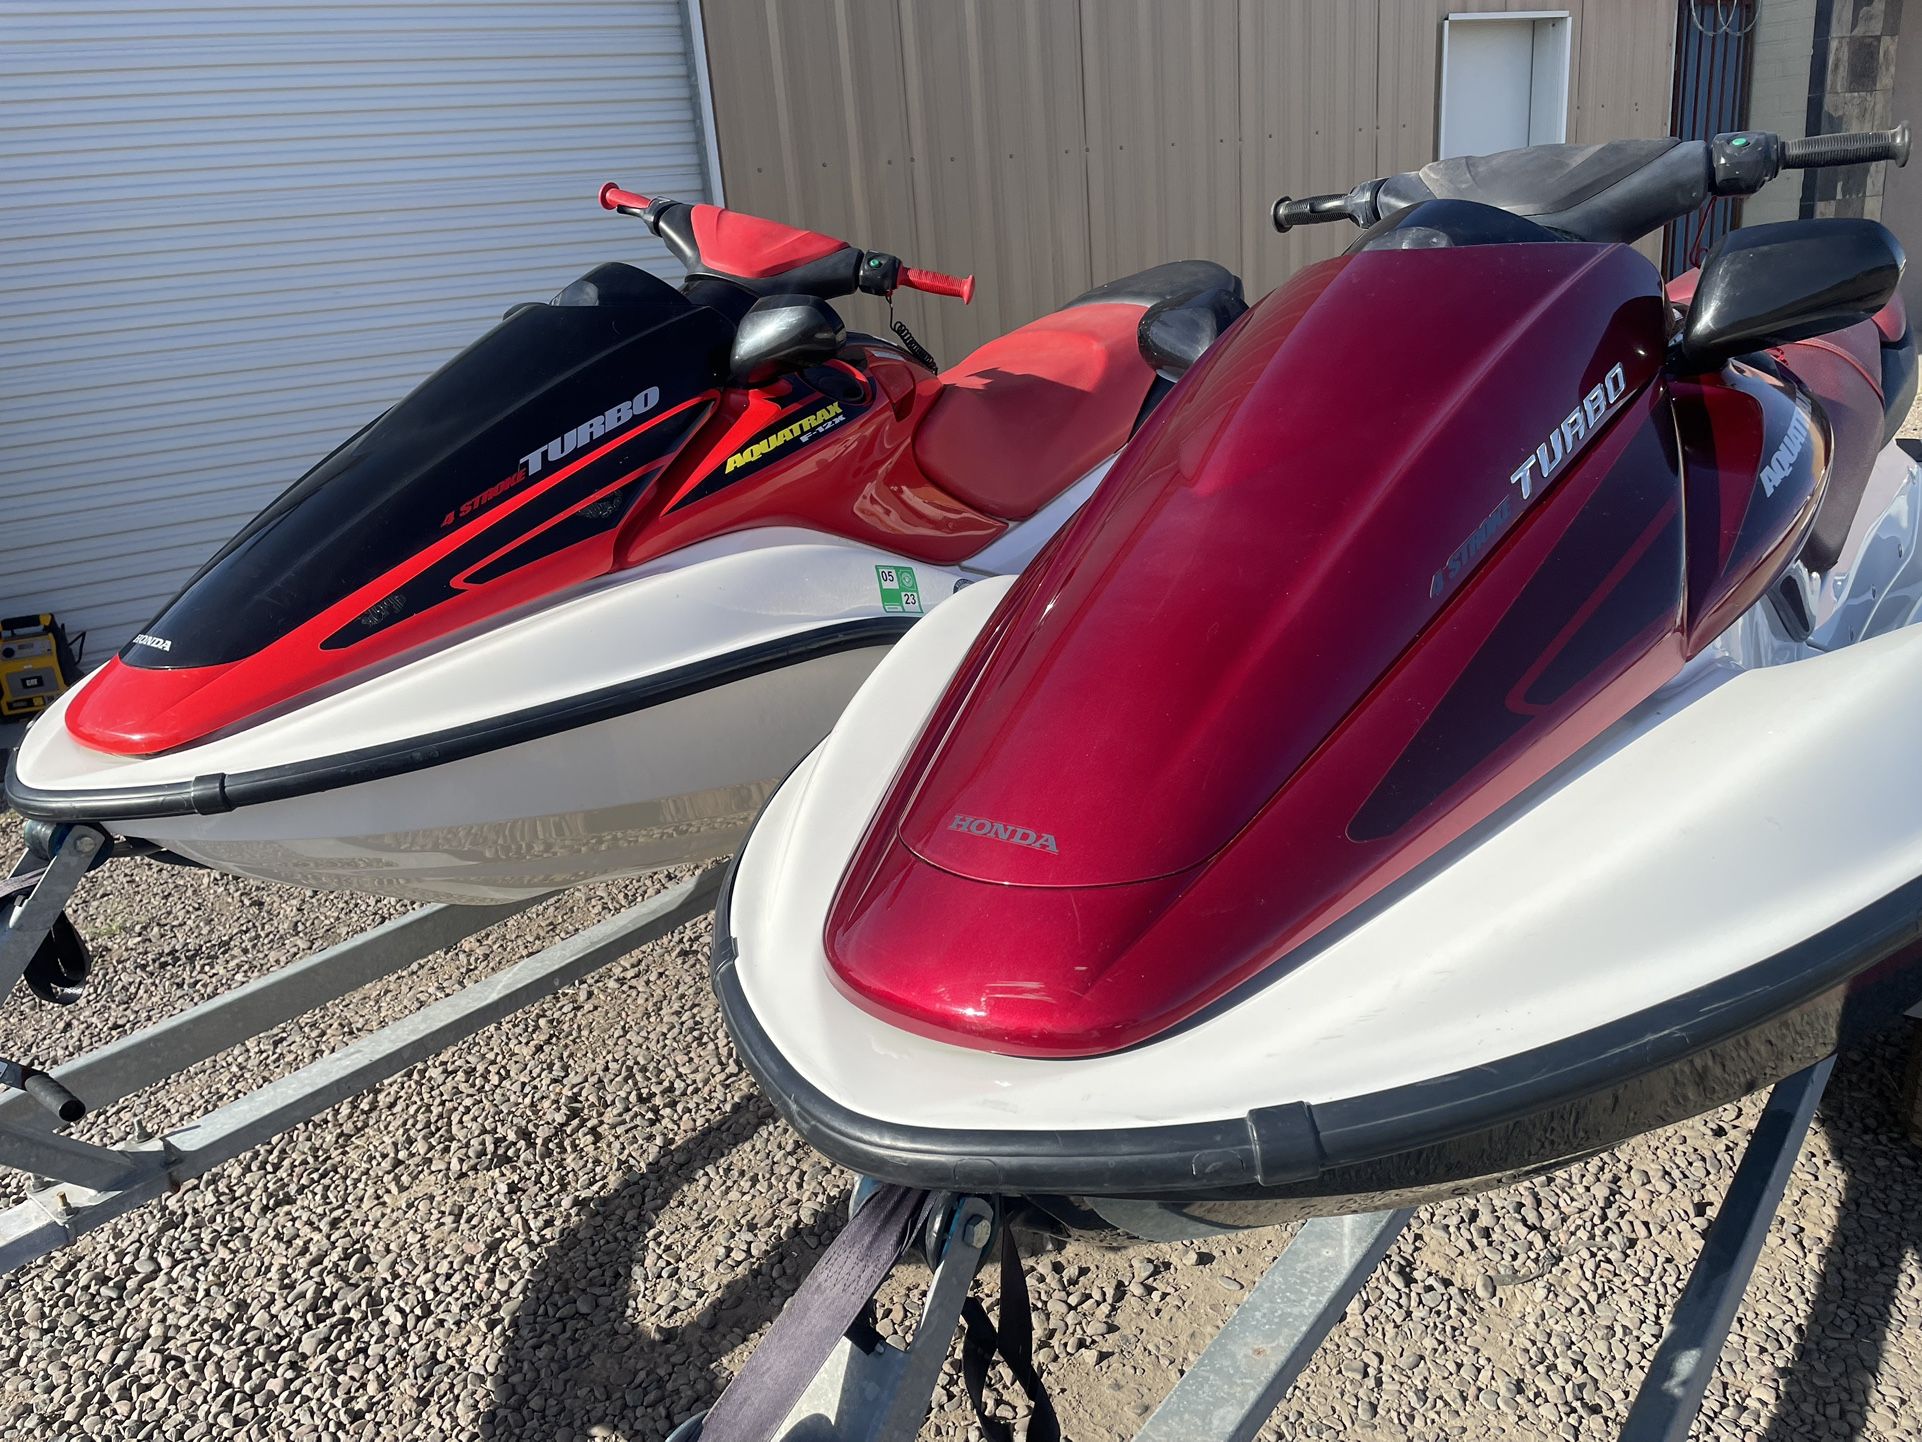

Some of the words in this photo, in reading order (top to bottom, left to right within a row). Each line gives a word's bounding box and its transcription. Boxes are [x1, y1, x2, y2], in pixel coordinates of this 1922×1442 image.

[725, 401, 843, 474] AQUATRAX
[799, 414, 846, 443] F-12X
[1509, 361, 1628, 501] TURBO
[440, 510, 455, 528] 4
[459, 467, 527, 517] STROKE
[519, 385, 660, 477] TURBO
[880, 570, 895, 582] 05
[903, 593, 917, 605] 23
[132, 633, 172, 652] HONDA
[949, 813, 1060, 855] HONDA
